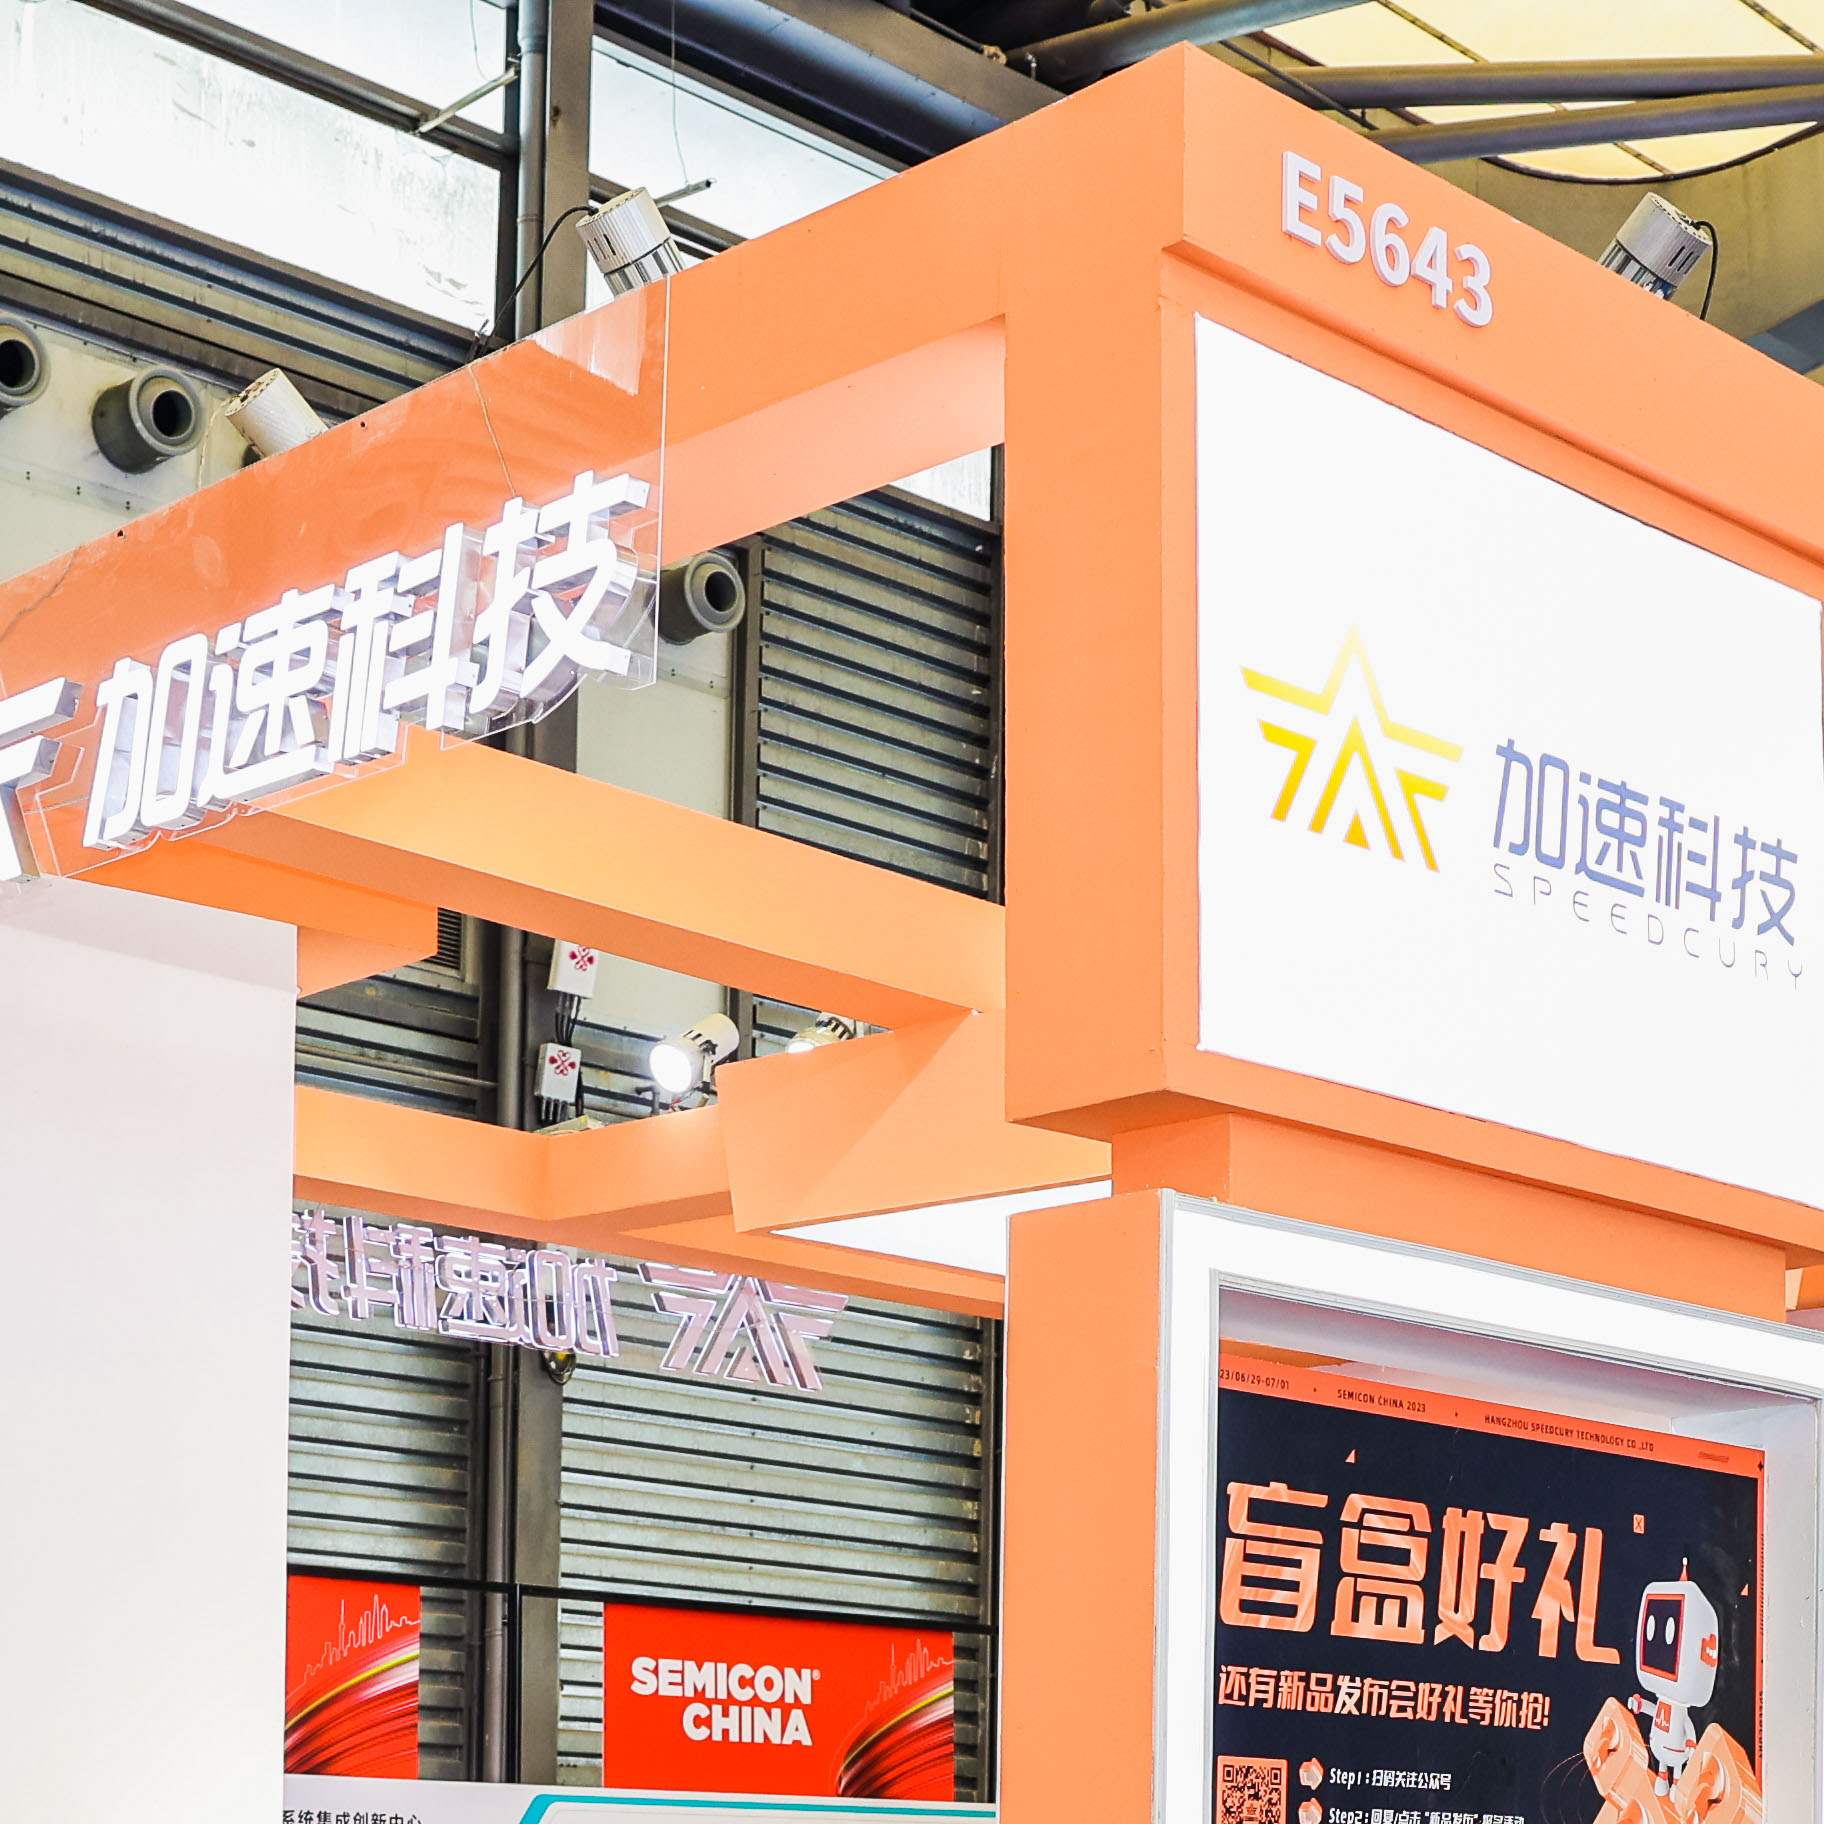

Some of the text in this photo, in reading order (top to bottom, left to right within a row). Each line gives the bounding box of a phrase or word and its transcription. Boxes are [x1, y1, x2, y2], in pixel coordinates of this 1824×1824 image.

[1281, 150, 1495, 328] E5643
[84, 470, 651, 851] 加速科技
[1493, 738, 1800, 945] 加速科技
[1493, 864, 1804, 989] SPEEDCURY
[1336, 1388, 1426, 1413] SEMICON CHINA 2023
[1484, 1414, 1529, 1430] HANGZHOU
[1531, 1422, 1574, 1438] SPEEDCURY
[1576, 1429, 1625, 1447] TECHNOLOGY
[1219, 1481, 1620, 1664] 盲盒好礼
[682, 1703, 812, 1746] CHINA
